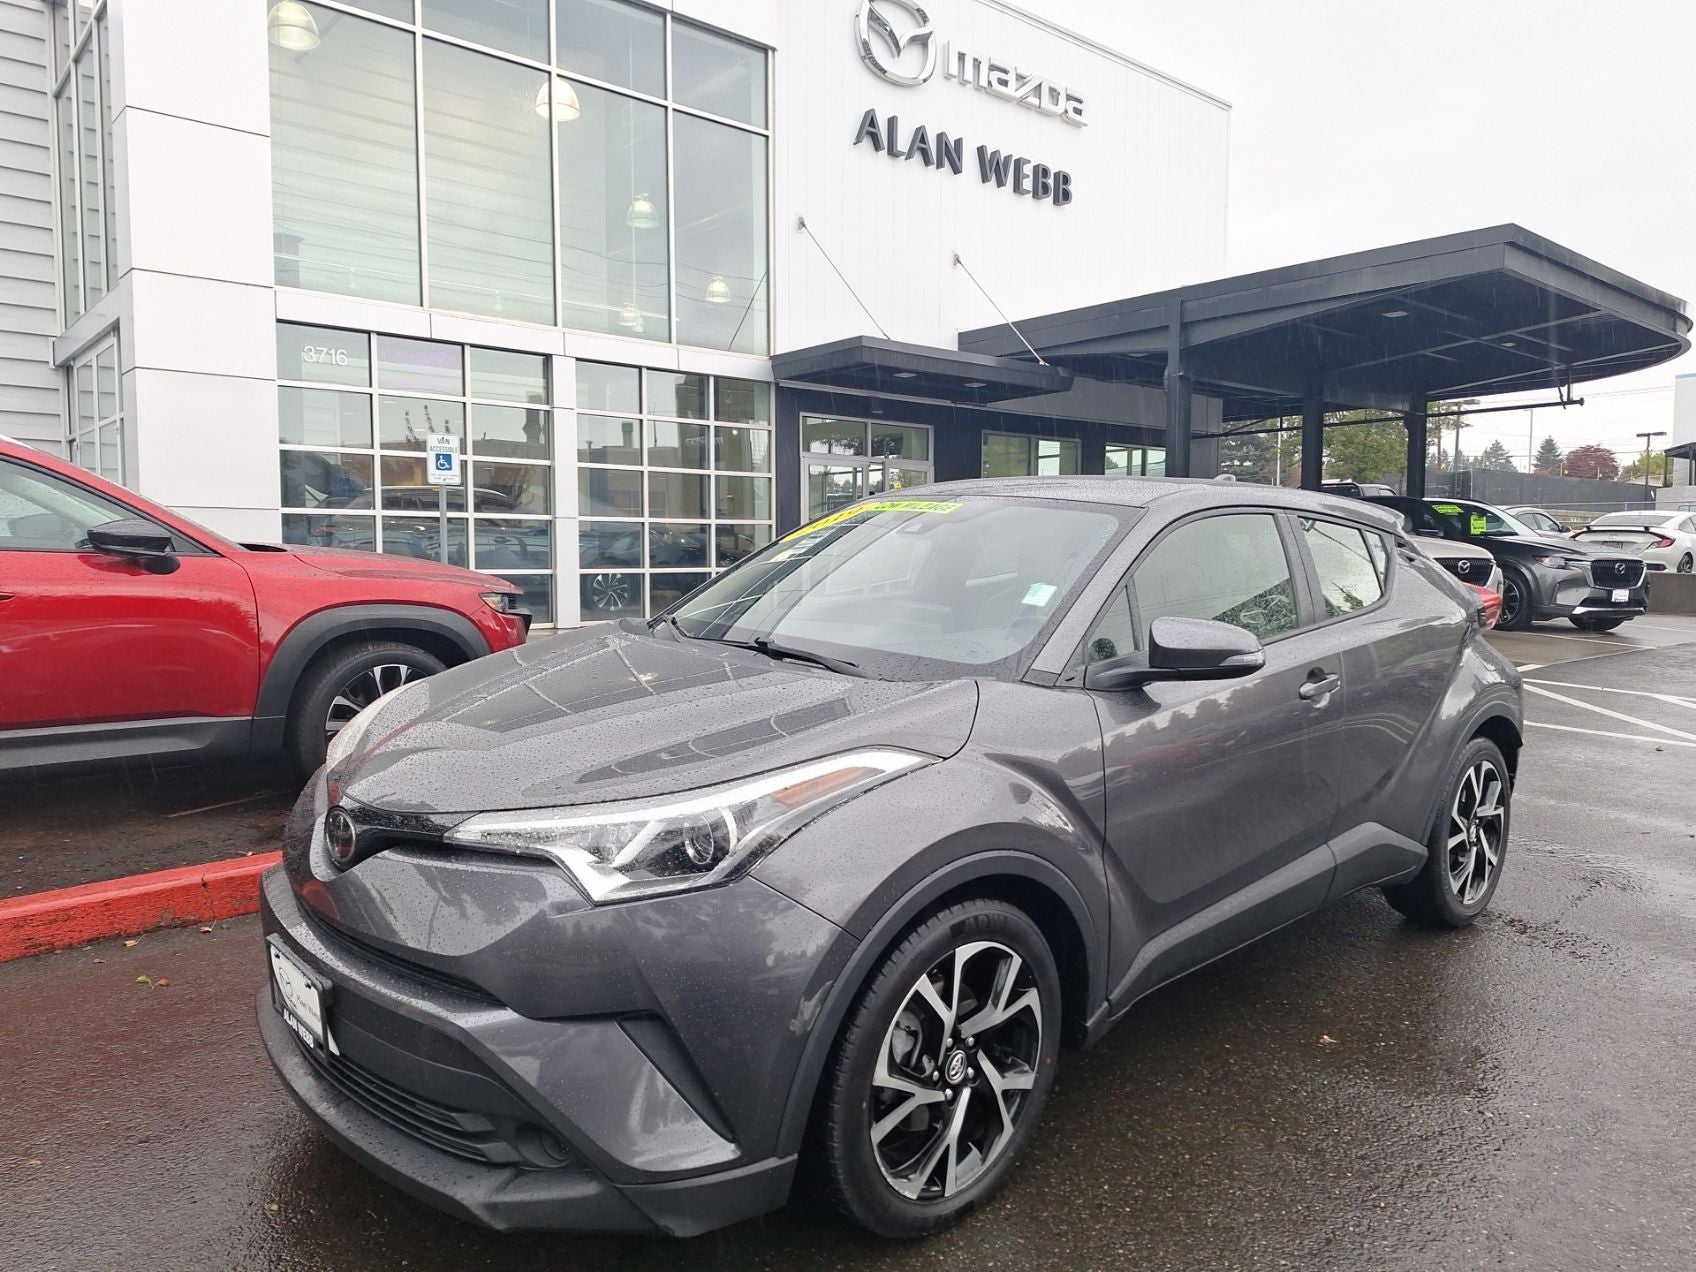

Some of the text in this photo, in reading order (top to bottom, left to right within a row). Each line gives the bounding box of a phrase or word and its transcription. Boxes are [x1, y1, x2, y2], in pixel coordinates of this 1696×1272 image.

[853, 108, 1073, 206] ALAN WEBB
[303, 345, 348, 366] 3716
[437, 437, 451, 445] VAN
